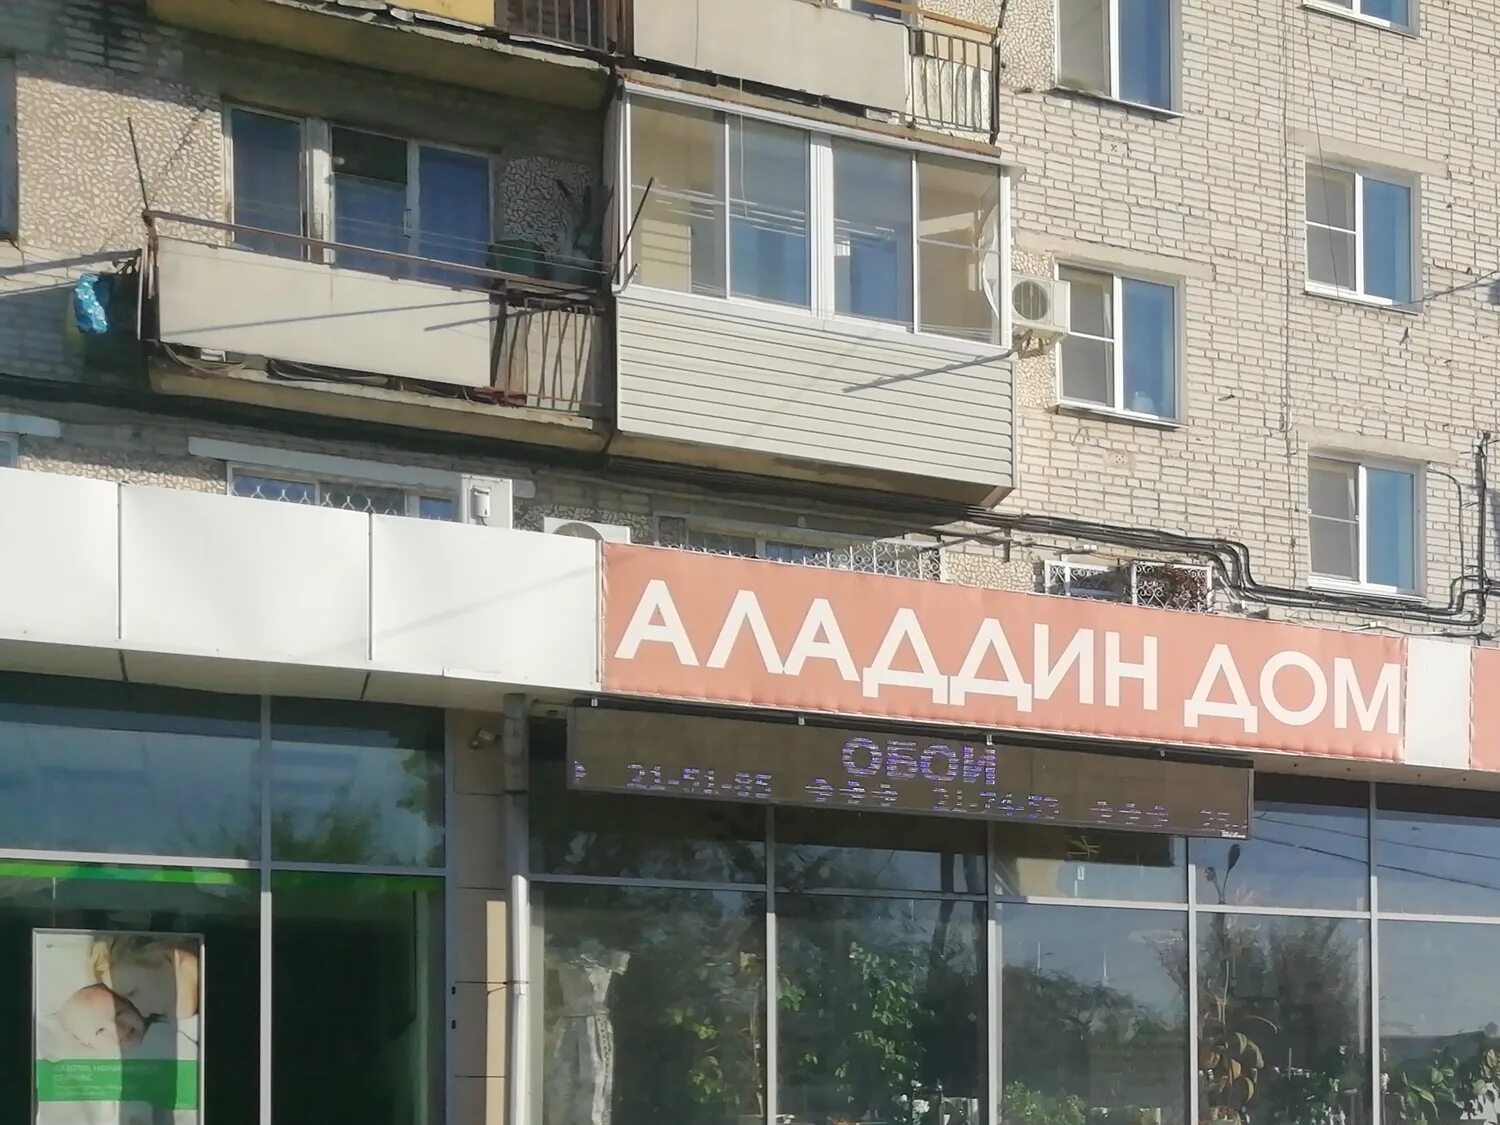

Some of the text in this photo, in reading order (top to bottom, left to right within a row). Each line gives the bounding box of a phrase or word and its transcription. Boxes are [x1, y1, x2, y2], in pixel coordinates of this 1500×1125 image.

[614, 579, 1400, 735] АЛАДДИН ДОМ
[841, 736, 998, 785] ОБОИ
